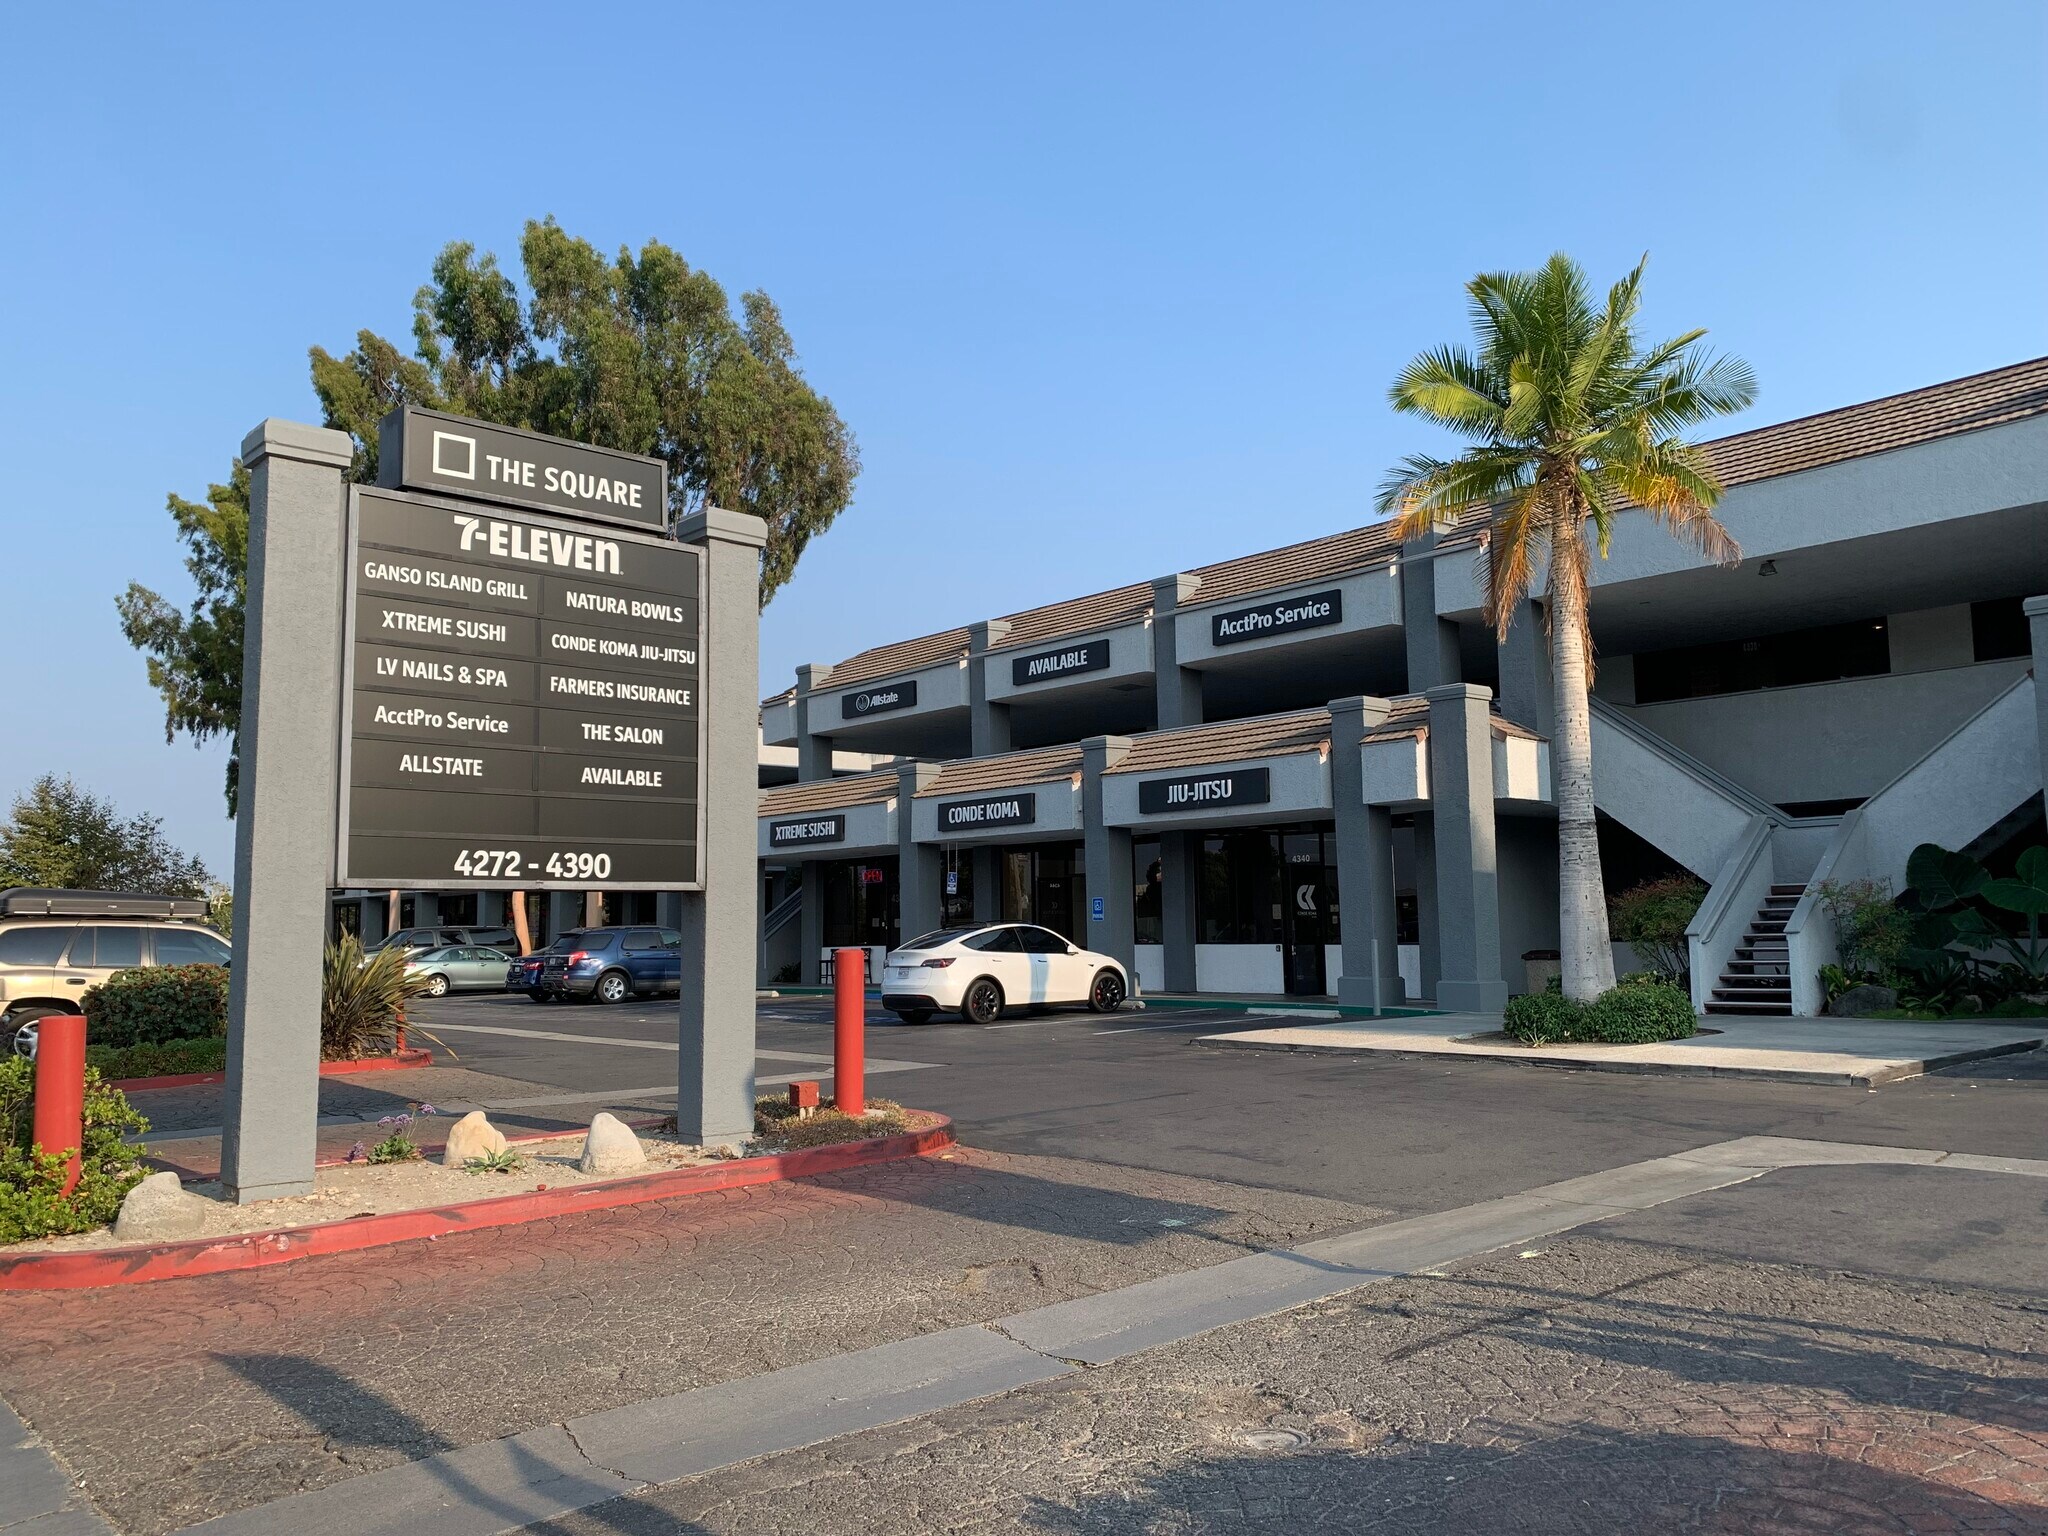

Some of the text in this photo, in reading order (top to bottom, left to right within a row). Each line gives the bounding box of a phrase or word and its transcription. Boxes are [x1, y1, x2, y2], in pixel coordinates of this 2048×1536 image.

[485, 454, 642, 509] THE SQUARE
[364, 561, 528, 600] GANSO ISLAND GRILL
[566, 590, 683, 623] NATURA BOWLS
[1219, 601, 1330, 637] AcctPro Service
[381, 609, 506, 642] XTREME SUSHI
[551, 633, 696, 665] CONDE KOMA JIU-JITSU
[1028, 649, 1088, 676] AVAILABLE
[376, 656, 508, 688] LV NAILS & SPA
[550, 676, 691, 706] FARMERS INSURANCE
[870, 692, 899, 707] Allstate
[374, 705, 509, 734] AcctPro Service
[581, 723, 664, 745] THE SALON
[399, 754, 483, 777] ALLSTATE
[580, 767, 662, 788] AVAILABLE
[1167, 779, 1232, 804] JIU-JITSU
[948, 800, 1020, 824] CONDE KOMA
[775, 820, 836, 841] XTREME SUSHI
[453, 849, 521, 877] 4272
[545, 852, 611, 879] 4390
[1292, 854, 1310, 862] 4340
